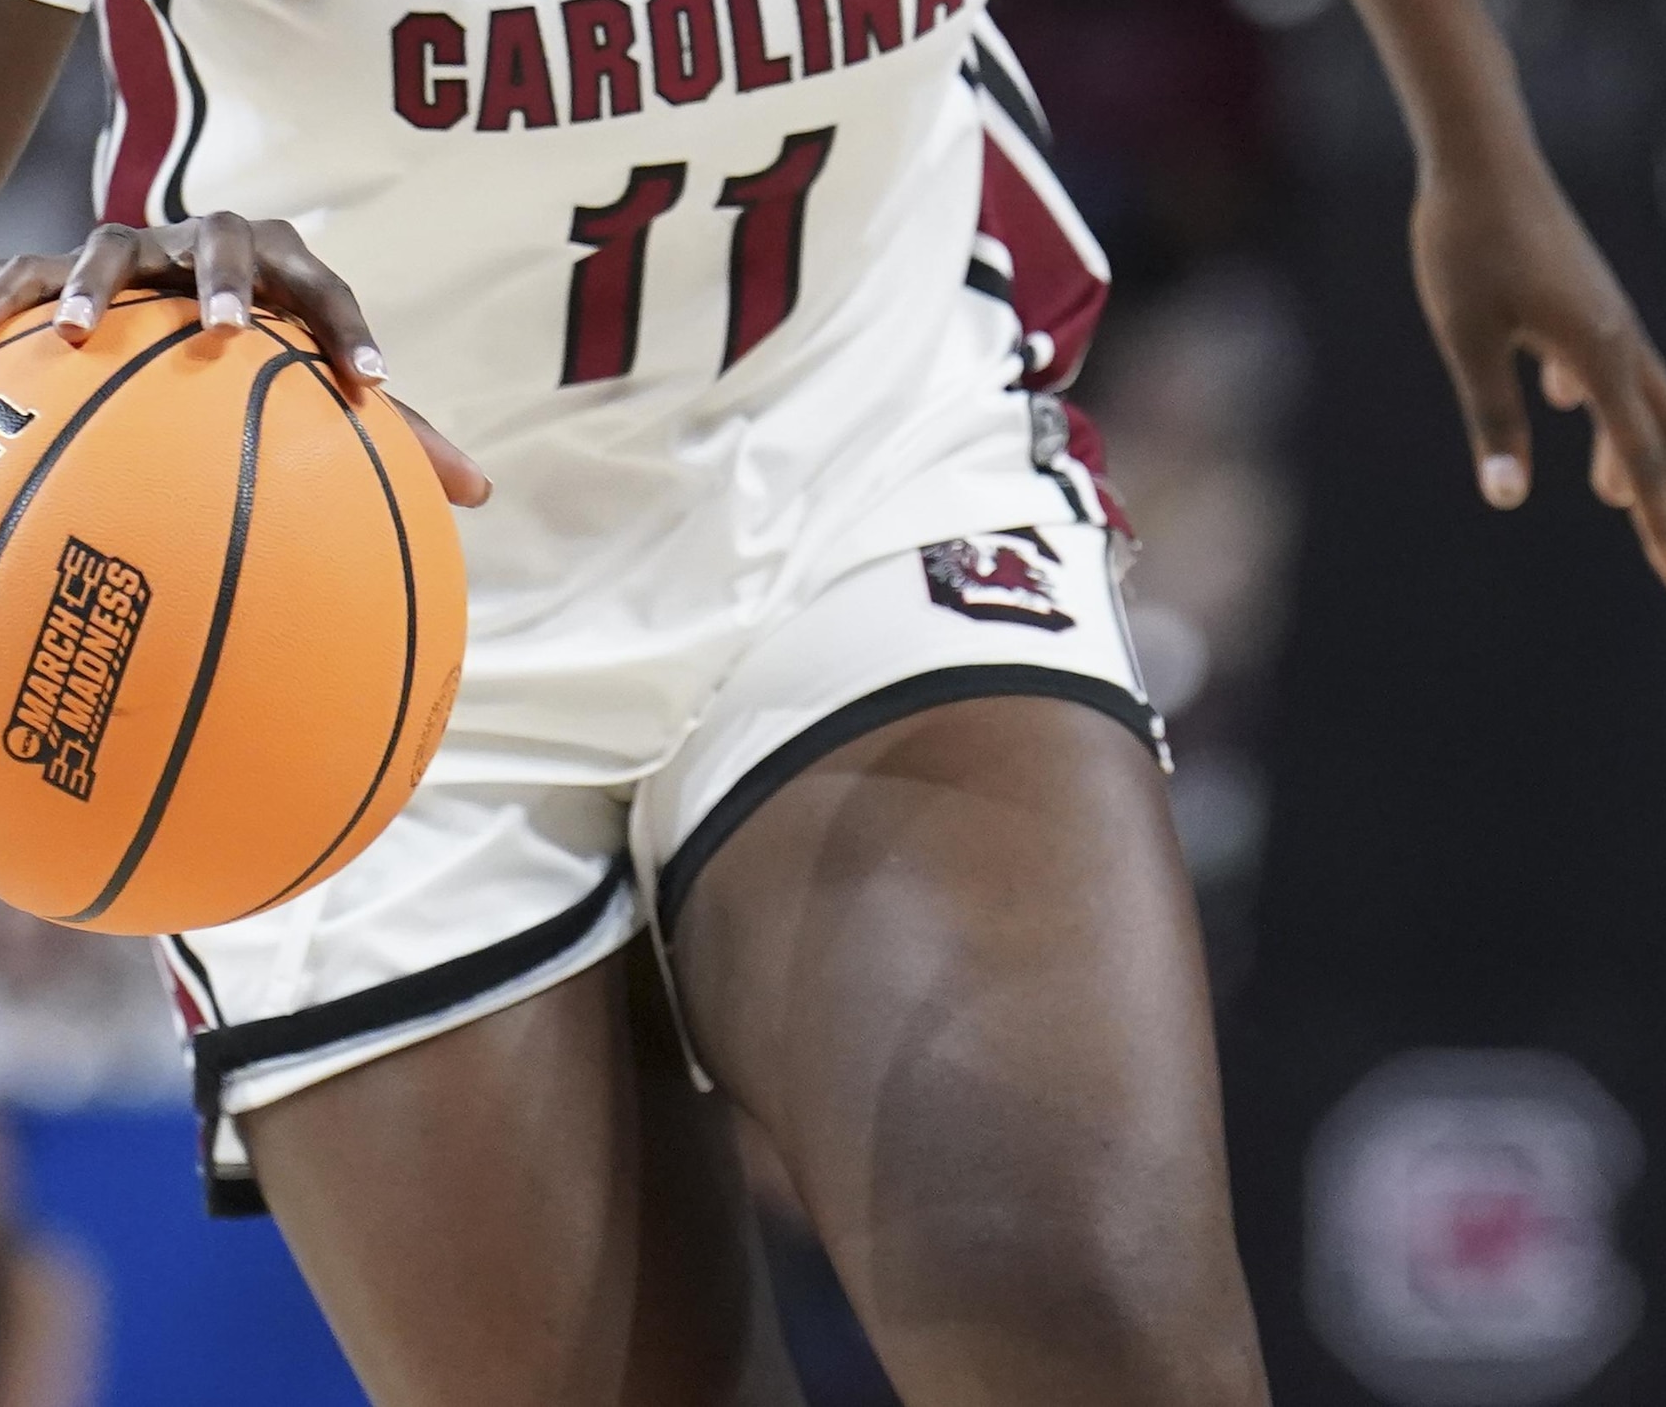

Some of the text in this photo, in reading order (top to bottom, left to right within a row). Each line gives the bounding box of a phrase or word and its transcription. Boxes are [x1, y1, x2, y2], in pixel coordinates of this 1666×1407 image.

[558, 125, 839, 386] 11
[17, 604, 85, 735] MARCH
[56, 561, 141, 735] MADNESS
